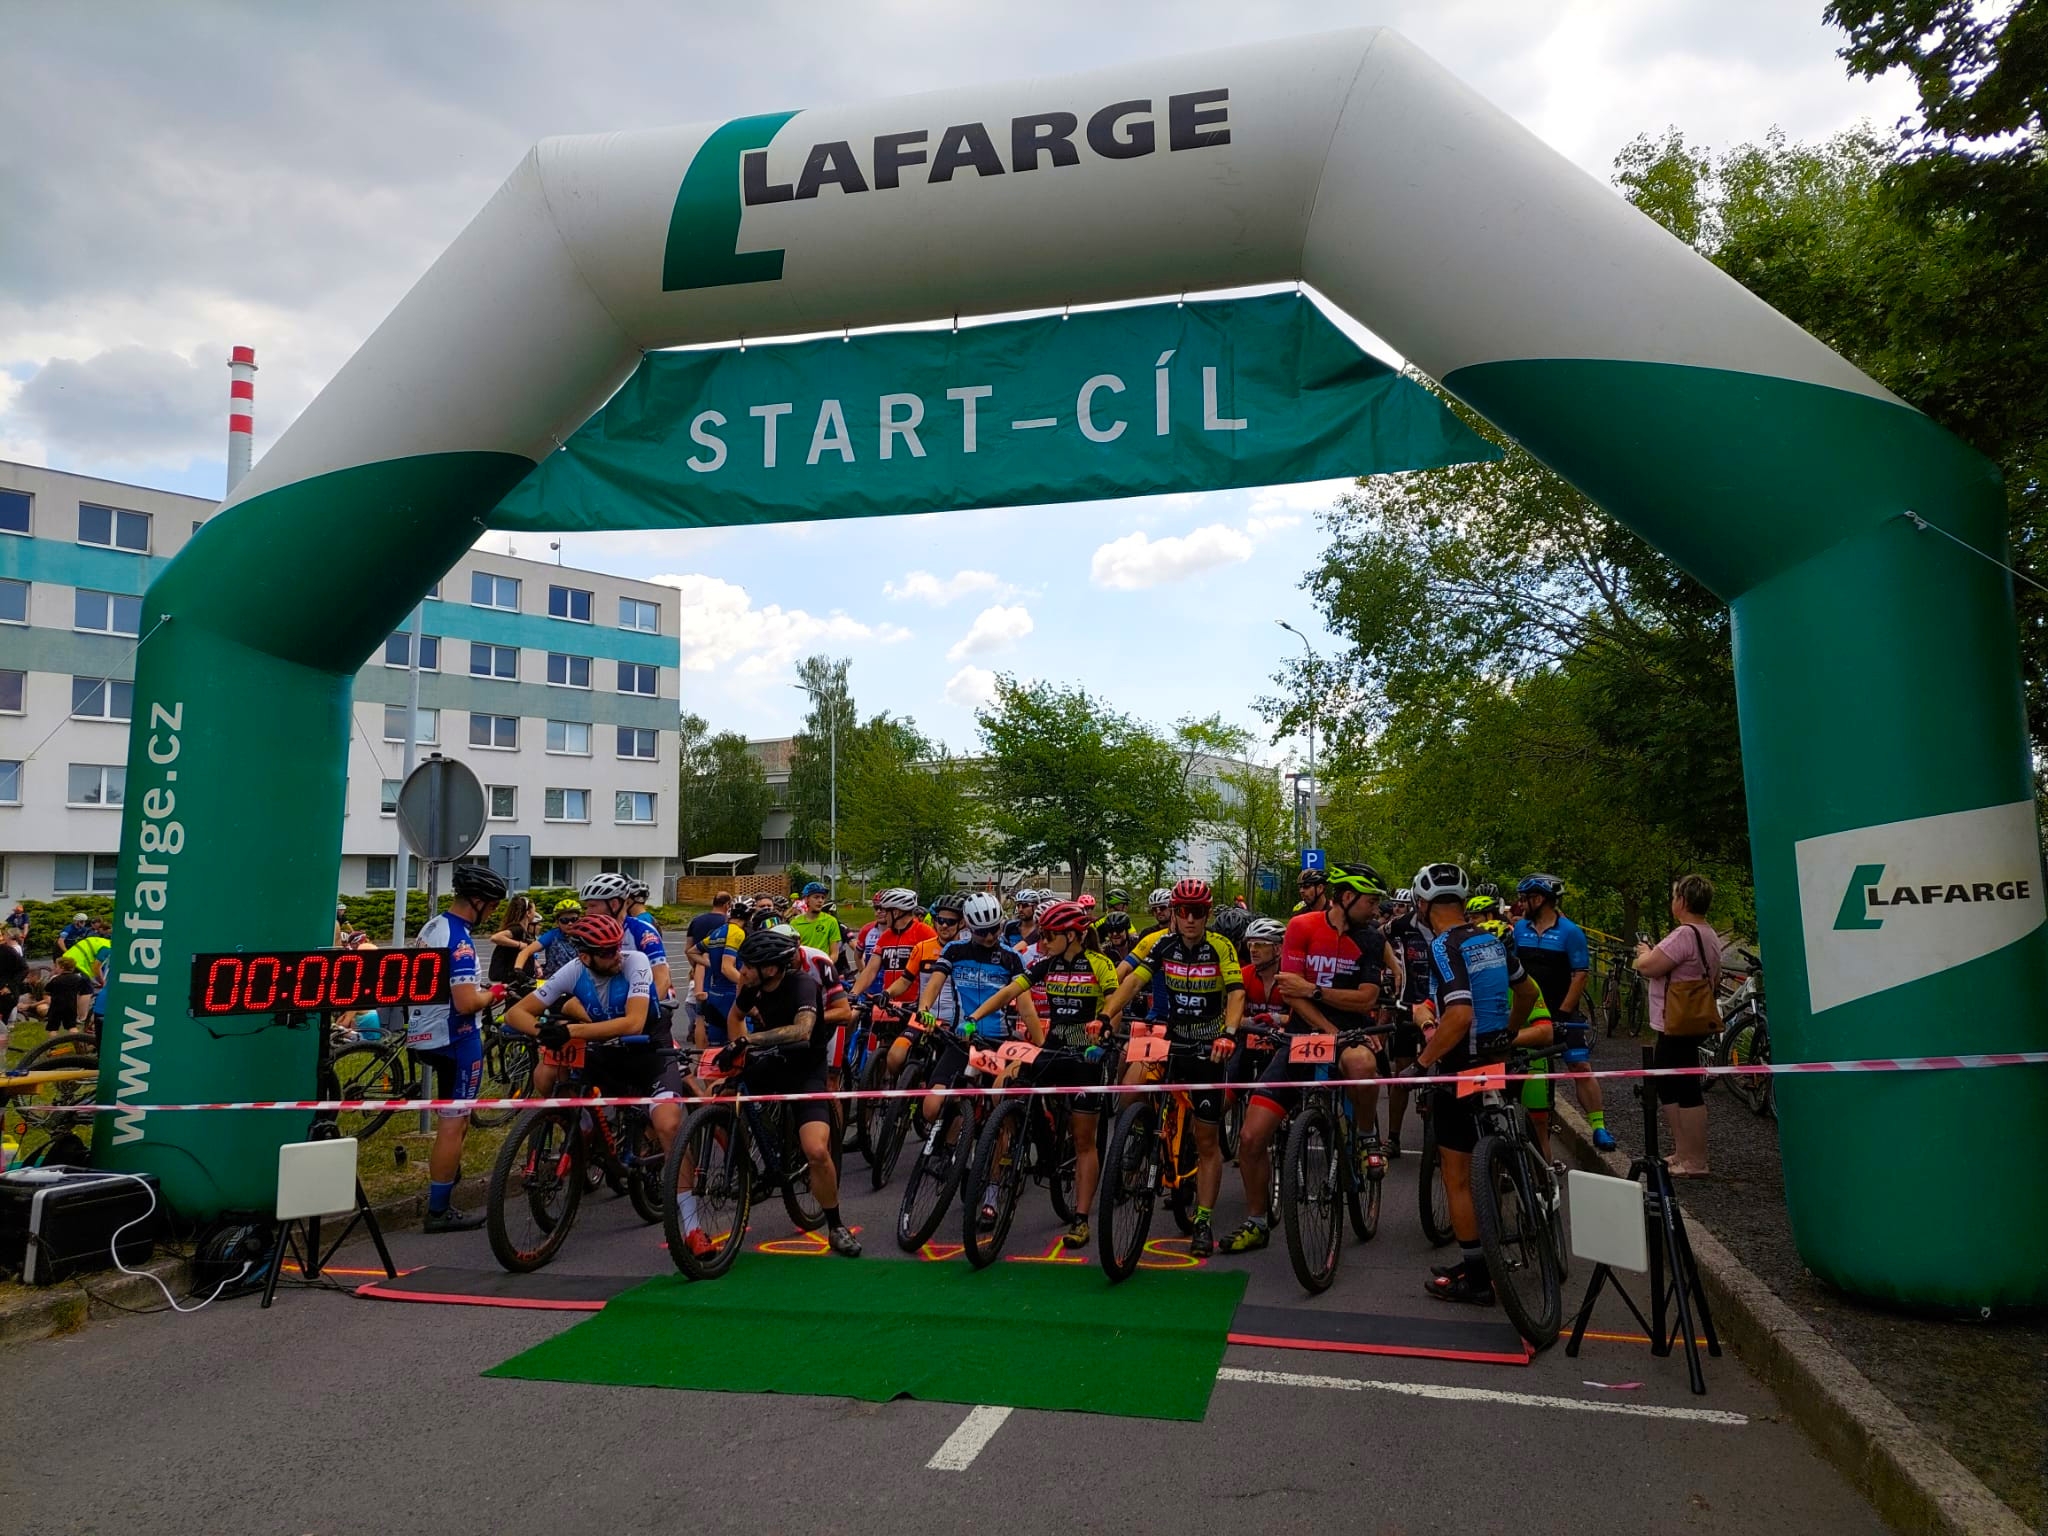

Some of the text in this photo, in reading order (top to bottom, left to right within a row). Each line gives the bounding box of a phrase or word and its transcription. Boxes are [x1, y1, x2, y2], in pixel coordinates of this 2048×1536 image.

[743, 88, 1231, 206] LAFARGE
[1307, 852, 1318, 868] P
[1868, 881, 2030, 906] LAFARGE
[112, 701, 185, 1147] www.lafarge.cz
[1165, 963, 1216, 977] HEAD
[204, 952, 441, 1012] 00:00.00
[1006, 1045, 1032, 1058] 67
[1145, 1042, 1152, 1058] 1
[1298, 1041, 1325, 1058] 46
